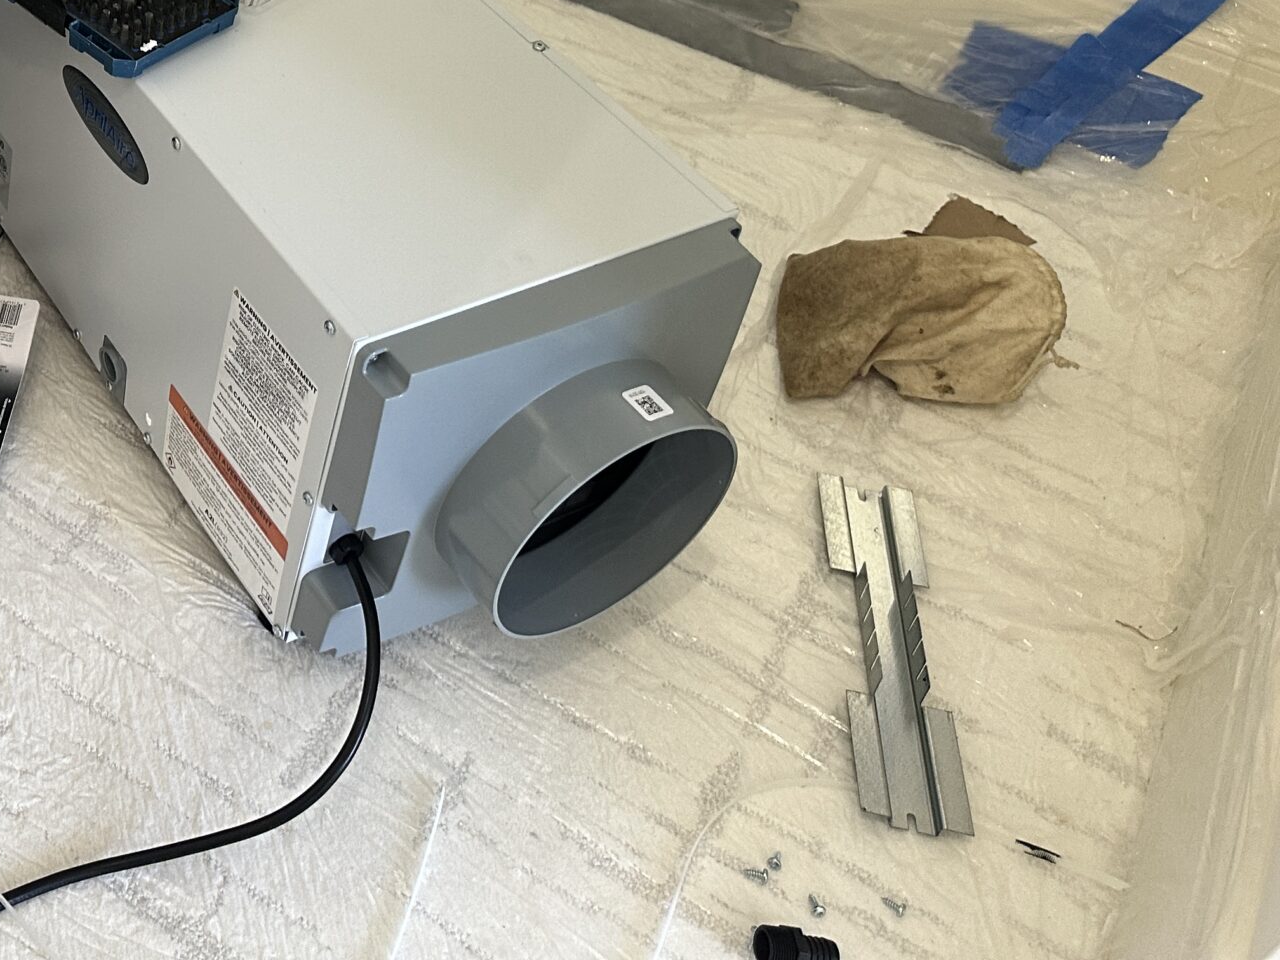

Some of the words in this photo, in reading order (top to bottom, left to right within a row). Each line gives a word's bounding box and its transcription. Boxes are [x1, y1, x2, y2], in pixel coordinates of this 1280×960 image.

[239, 294, 267, 334] WARNING
[269, 331, 316, 396] AVERTISSEMENT
[233, 389, 256, 424] CAUTION
[258, 422, 288, 466] ATTENTION
